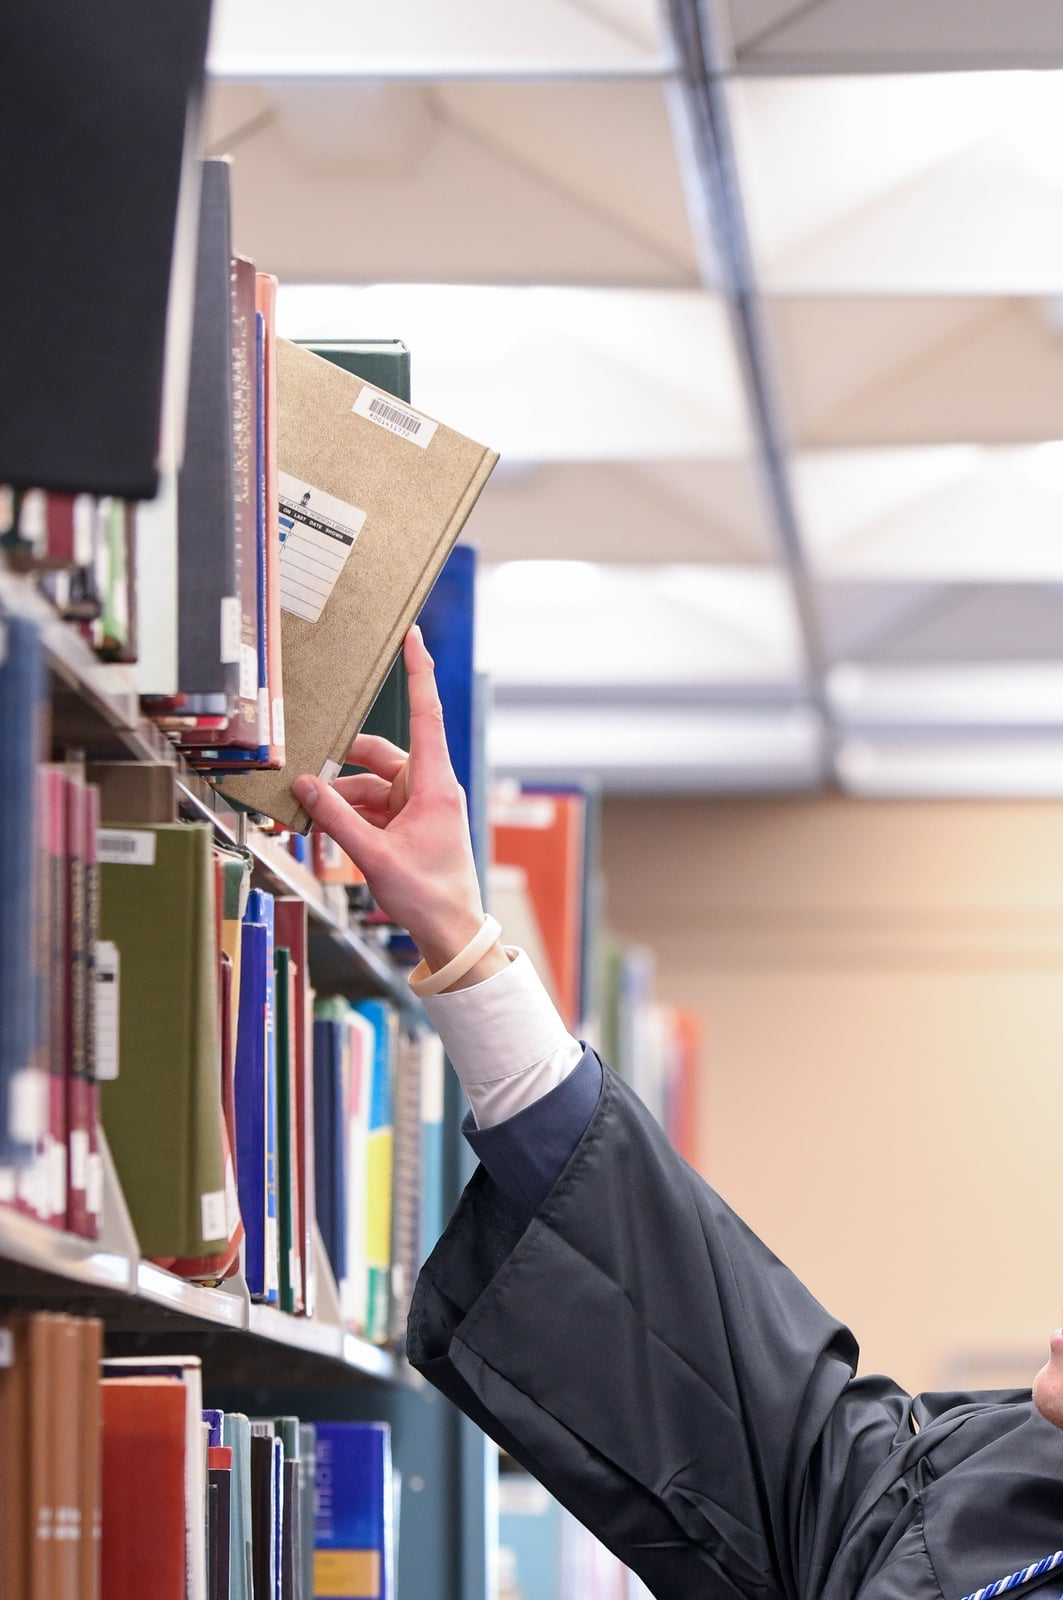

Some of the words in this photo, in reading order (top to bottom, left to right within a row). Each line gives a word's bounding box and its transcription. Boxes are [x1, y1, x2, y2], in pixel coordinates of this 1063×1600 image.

[283, 507, 292, 515] ON
[294, 512, 307, 522] LAST
[309, 520, 323, 530] DATE
[325, 527, 344, 540] SHOWN
